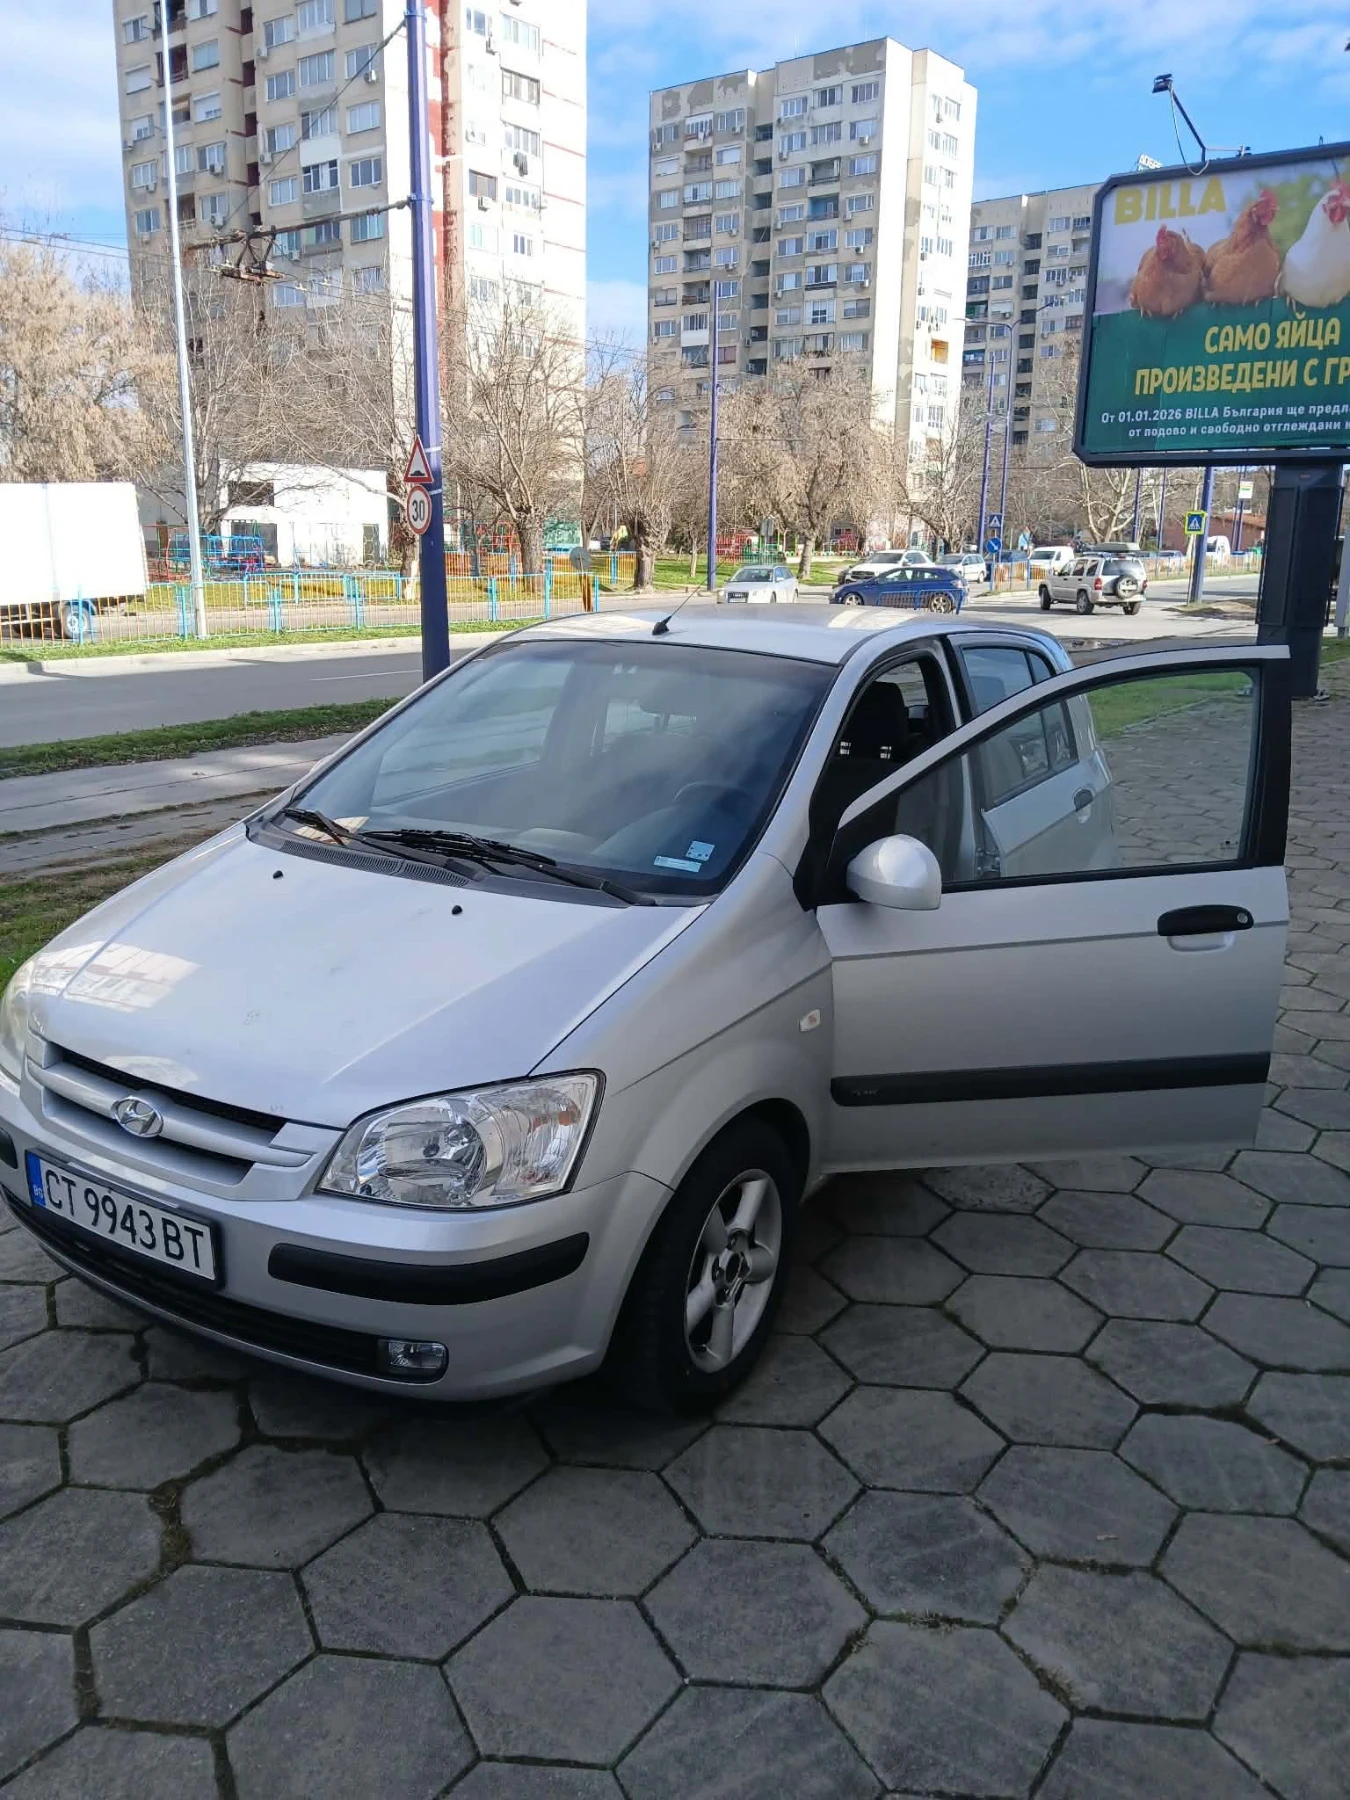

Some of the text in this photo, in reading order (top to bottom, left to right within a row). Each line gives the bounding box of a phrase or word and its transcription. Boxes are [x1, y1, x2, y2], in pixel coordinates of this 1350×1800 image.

[1115, 176, 1226, 225] BILLA
[1204, 311, 1341, 354] САМО ЯЙЦА
[1134, 359, 1298, 395] ПРОИЗВЕДЕНИ
[1303, 358, 1319, 387] С
[1101, 412, 1116, 423] От
[1118, 407, 1182, 423] 01.01.2026
[1185, 406, 1219, 420] BILLA
[1223, 405, 1283, 419] България
[1287, 405, 1305, 417] ще
[1128, 428, 1142, 437] от
[1144, 426, 1187, 439] подово
[1190, 426, 1197, 435] и
[1201, 421, 1260, 435] свободно
[1263, 420, 1341, 433] отглеждани
[412, 500, 426, 522] 30
[45, 1169, 204, 1269] CT 9943 BT
